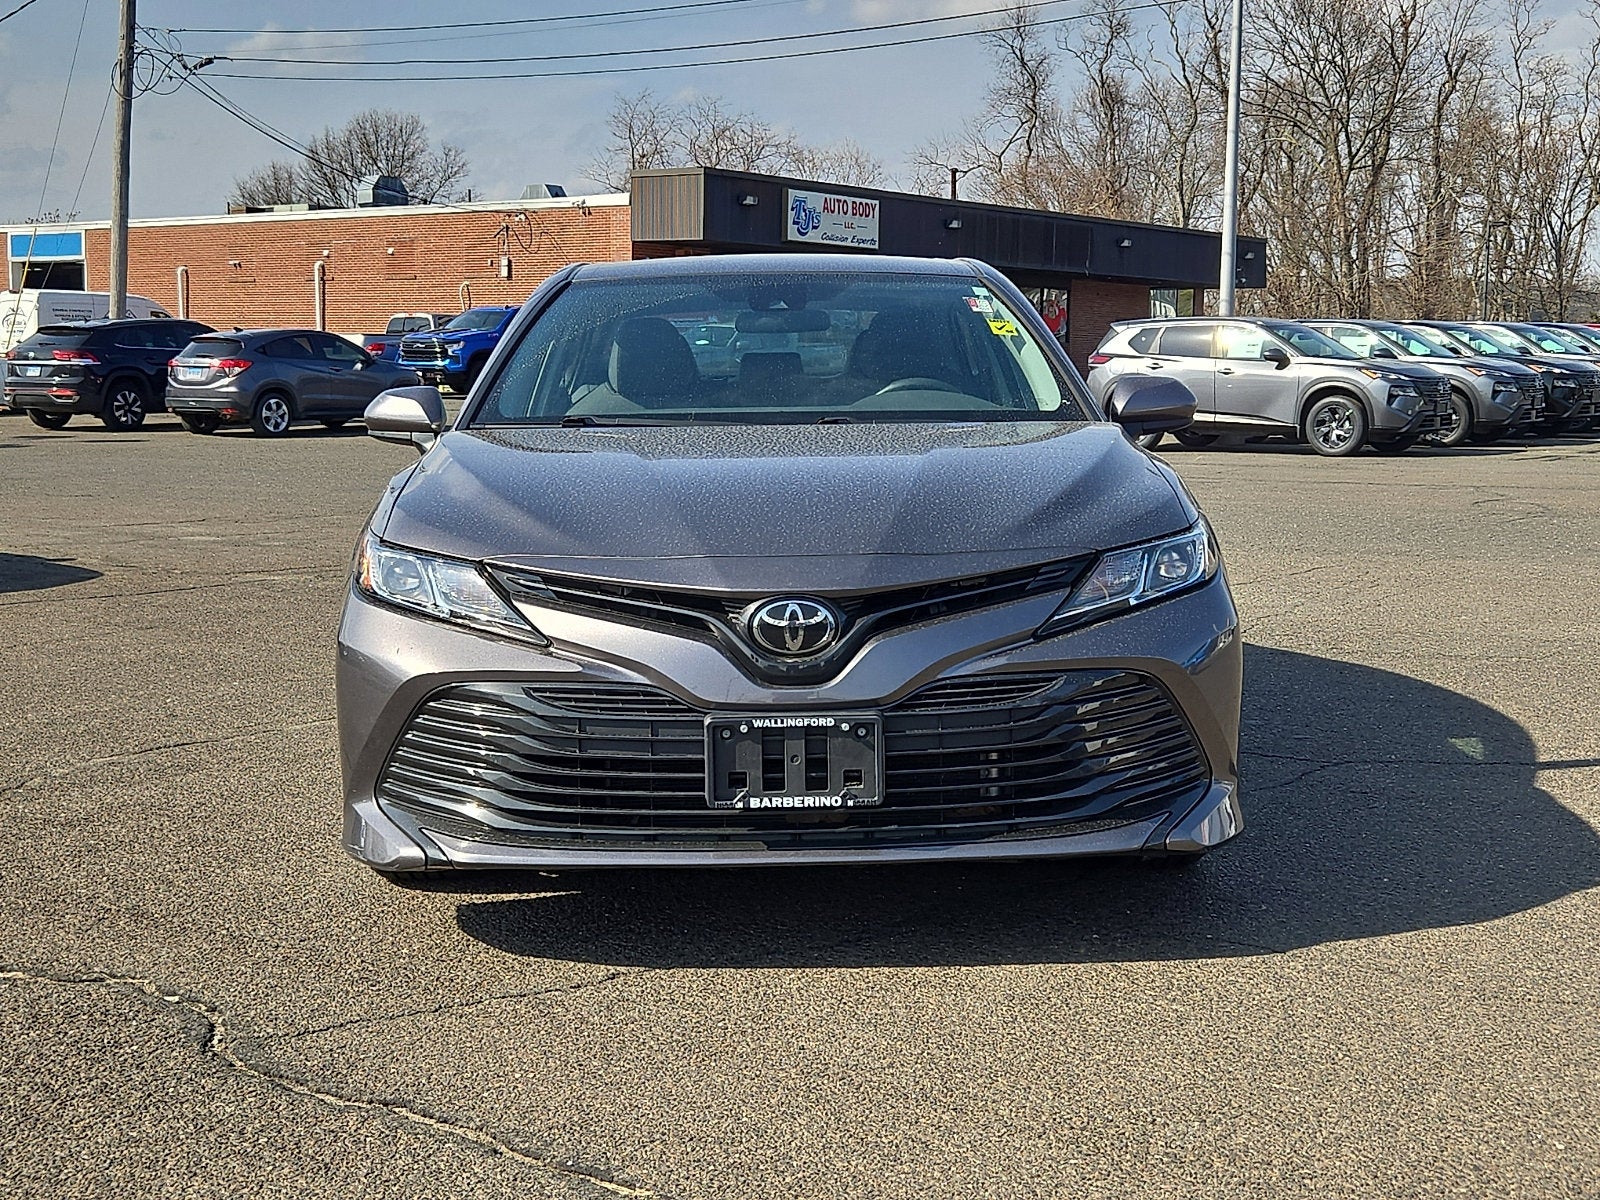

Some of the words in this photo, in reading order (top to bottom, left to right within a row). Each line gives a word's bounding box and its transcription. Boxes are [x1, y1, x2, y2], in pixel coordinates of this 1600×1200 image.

[822, 197, 849, 216] AUTO
[851, 200, 877, 219] BODY
[844, 221, 856, 230] LLC.
[821, 232, 849, 243] Collision
[850, 235, 877, 246] Experts
[752, 717, 835, 728] WALLINGFORD
[750, 796, 842, 809] BARBERINO
